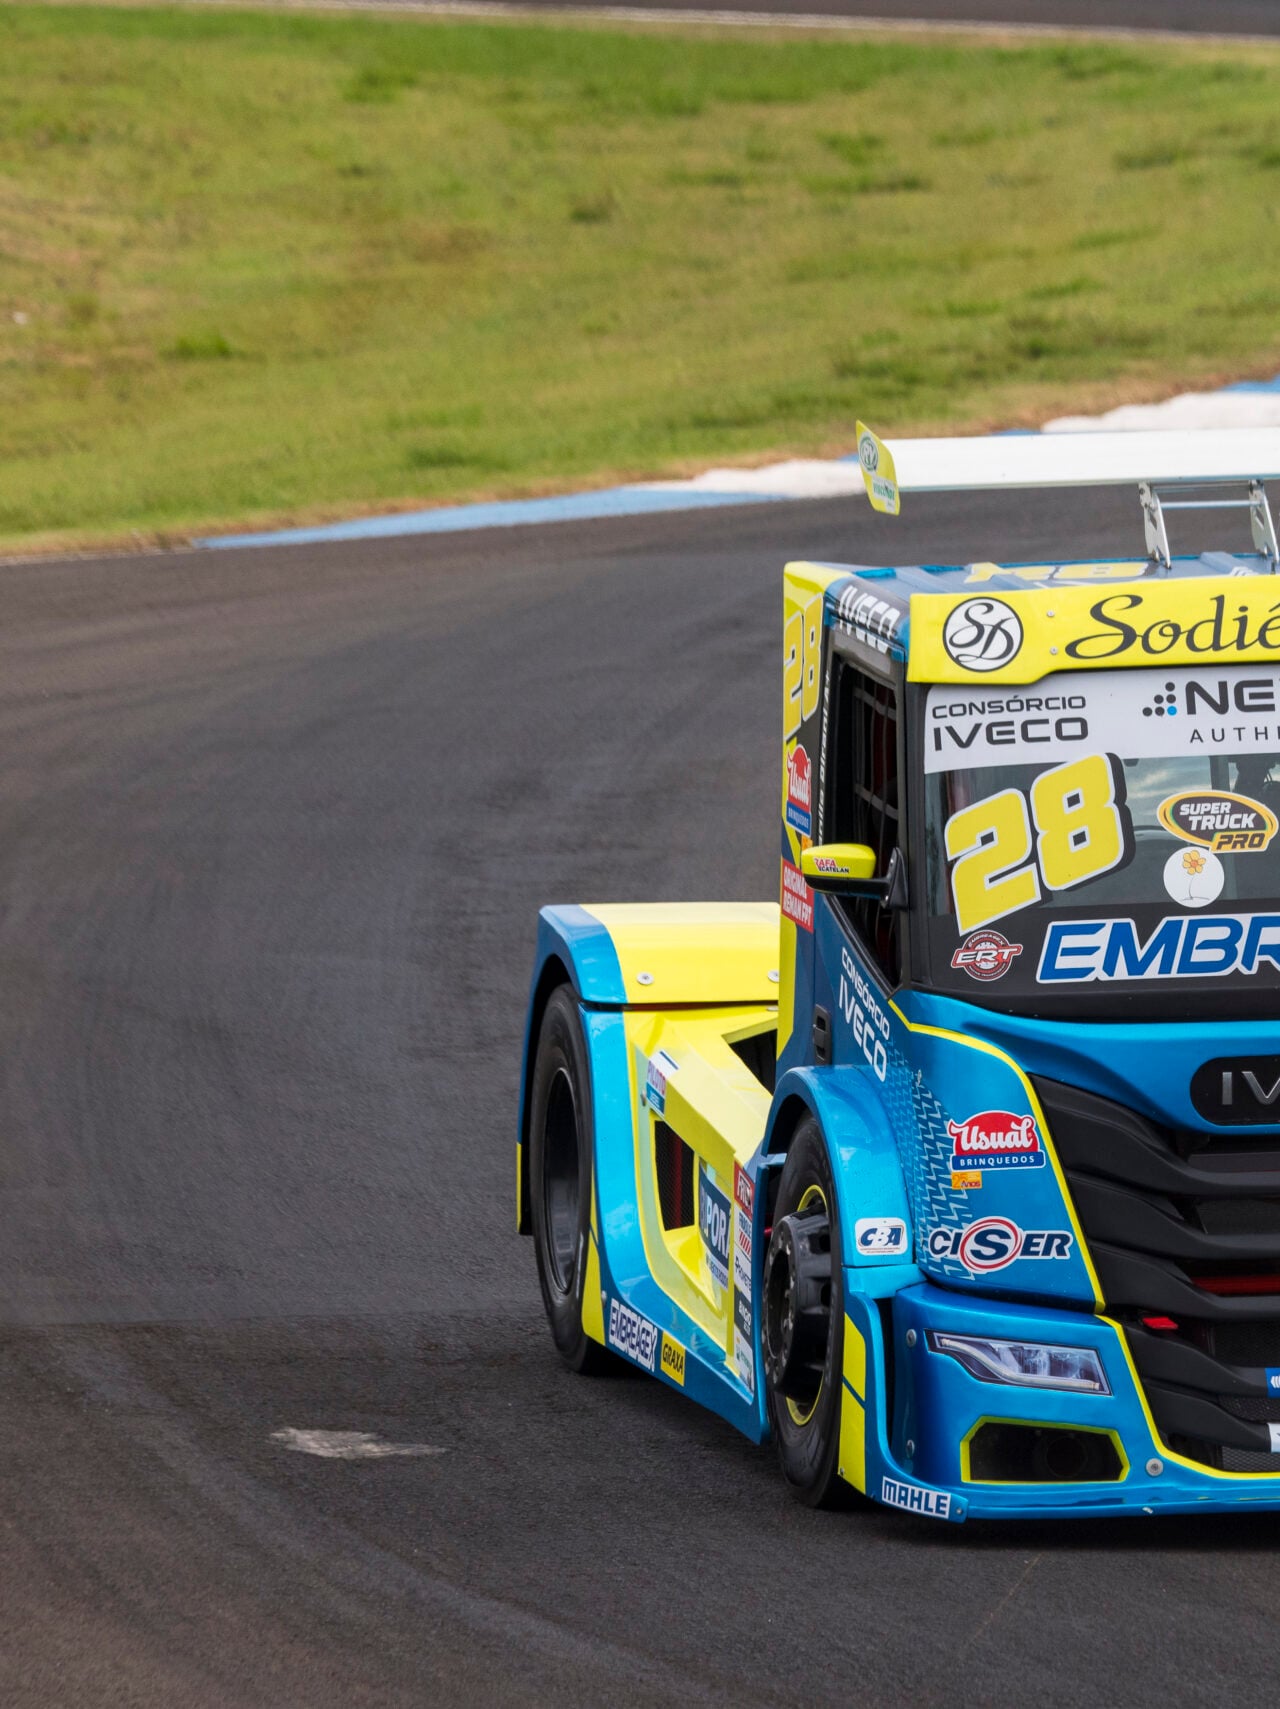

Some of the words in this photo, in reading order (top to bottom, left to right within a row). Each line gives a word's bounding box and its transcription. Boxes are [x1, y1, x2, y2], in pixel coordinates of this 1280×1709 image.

[932, 695, 1086, 719] CONSÓRCIO
[934, 717, 1088, 751] IVECO
[1180, 802, 1231, 816] SUPER
[1189, 813, 1257, 831] TRUCK
[945, 753, 1127, 937] 28
[1216, 833, 1266, 850] PRO
[956, 948, 1017, 964] ERT
[842, 947, 890, 1040] CONSÓRCIO
[839, 974, 887, 1082] IVECO
[950, 1116, 1034, 1151] Usual
[959, 1155, 1035, 1167] BRINQUEDOS
[861, 1227, 902, 1247] CBA
[930, 1228, 1071, 1261] CISER
[610, 1302, 657, 1366] EMBREAGEX
[662, 1343, 684, 1376] GRAXA
[883, 1479, 949, 1517] MAHLE
